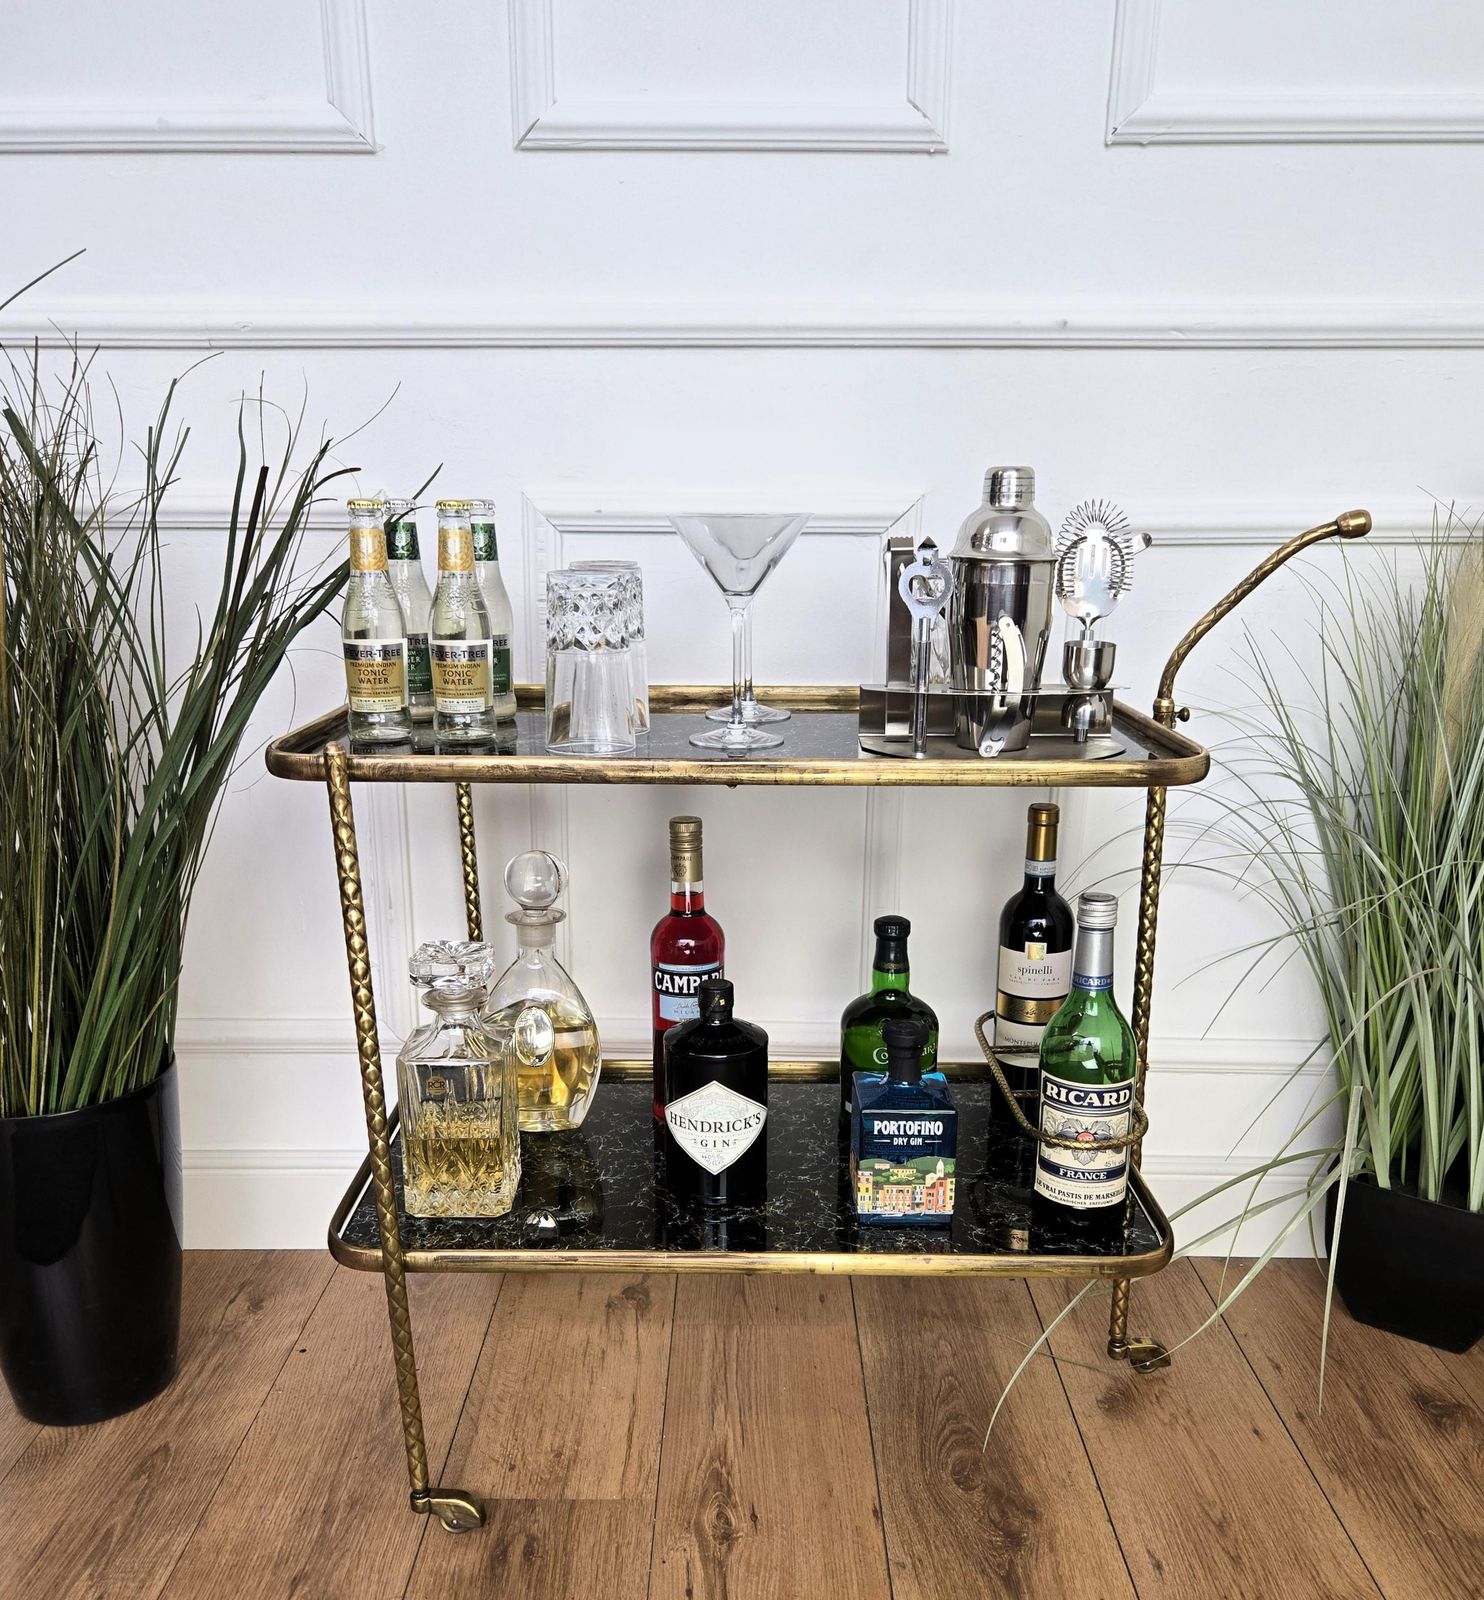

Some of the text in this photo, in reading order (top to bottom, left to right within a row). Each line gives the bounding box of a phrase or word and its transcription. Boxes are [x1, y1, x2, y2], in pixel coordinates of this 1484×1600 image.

[345, 648, 401, 658] FEVER-TREE
[431, 648, 486, 659] FEVER-TREE
[358, 669, 388, 677] TONIC
[442, 669, 472, 677] TONIC
[358, 677, 389, 685] WATER
[442, 678, 473, 686] WATER
[1017, 965, 1053, 976] spinelli
[1045, 1081, 1130, 1107] RICARD
[669, 1110, 761, 1134] HENDRICK'S
[873, 1120, 944, 1136] PORTOFINO
[700, 1139, 731, 1148] GIN
[893, 1137, 923, 1146] DRY GIN
[1059, 1167, 1108, 1180] FRANCE
[1042, 1182, 1057, 1194] VRAI
[1057, 1189, 1082, 1200] PASTIS
[1095, 1185, 1126, 1200] MARSEILLE
